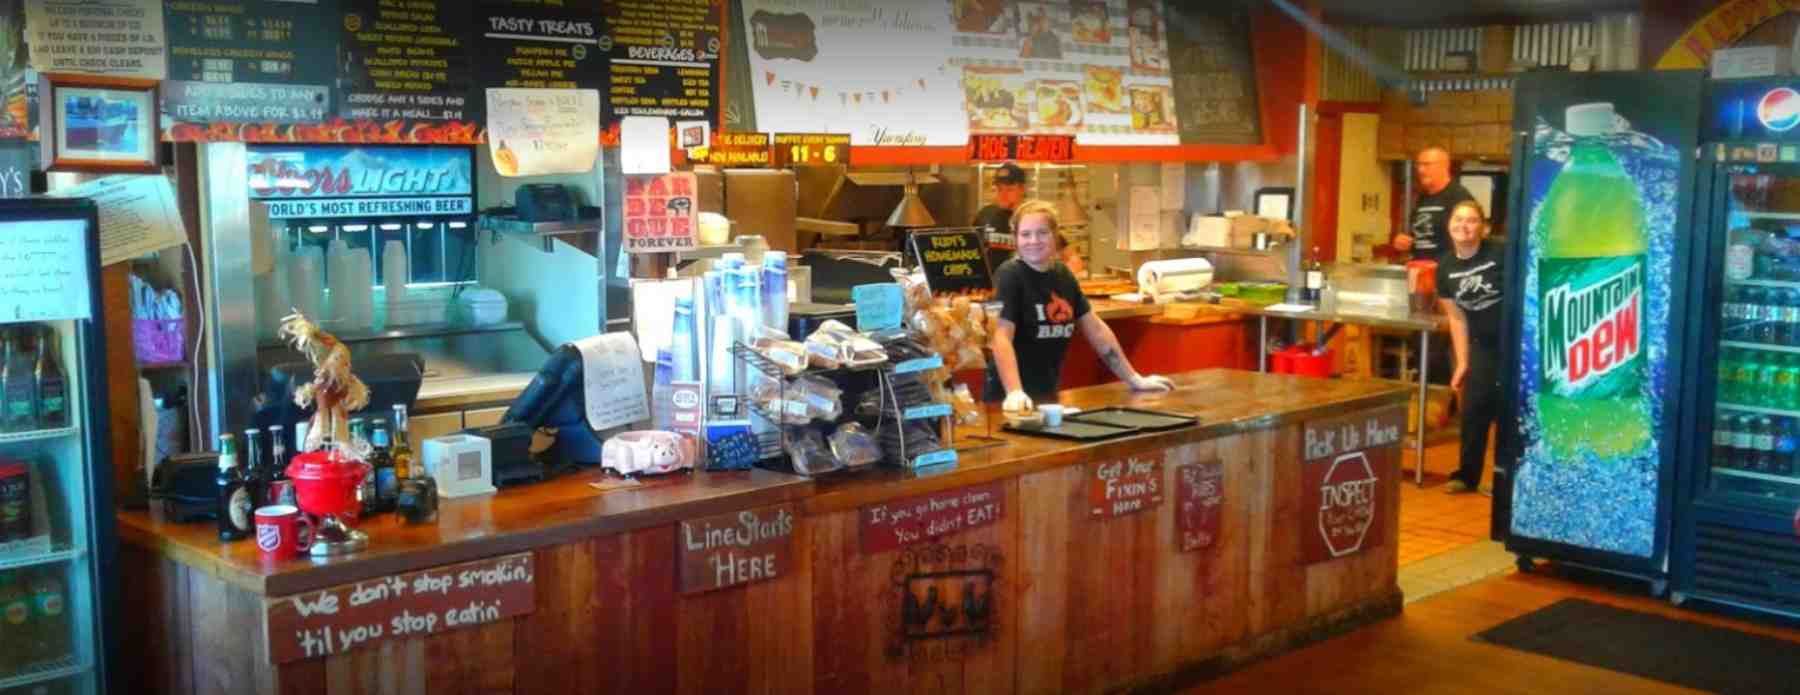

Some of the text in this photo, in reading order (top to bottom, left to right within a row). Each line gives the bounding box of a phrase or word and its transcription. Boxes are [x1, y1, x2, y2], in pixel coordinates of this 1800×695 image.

[489, 16, 594, 36] TASTY TREATS
[628, 46, 695, 61] BEVERAGES
[417, 95, 443, 105] SIDES
[446, 97, 464, 106] AND
[177, 104, 210, 116] ITEM
[216, 104, 258, 117] ABOVE
[263, 105, 288, 118] FOR
[791, 145, 809, 162] 11
[823, 145, 837, 162] 6
[979, 135, 1070, 158] HOG HEAVEN
[353, 166, 449, 194] LIGHT
[626, 177, 692, 196] BAR
[321, 202, 354, 214] MOST
[358, 200, 432, 213] REFRESHING
[434, 199, 464, 211] BEER
[626, 197, 668, 217] BE
[627, 217, 690, 237] QUE
[629, 237, 694, 248] FOREVER
[931, 235, 967, 248] RUDY'S
[924, 248, 981, 262] HOMEMADE
[944, 264, 974, 276] CHIPS
[1096, 460, 1121, 480] Get
[1320, 477, 1379, 511] INSPECT
[871, 504, 888, 525] If
[890, 509, 913, 525] you
[929, 497, 961, 512] home
[681, 508, 793, 551] Line Starts
[707, 551, 777, 588] HERE
[292, 592, 340, 617] We
[349, 578, 407, 607] don't
[413, 573, 453, 595] stop
[297, 626, 334, 657] 'til
[339, 624, 384, 652] you
[391, 610, 438, 634] stop
